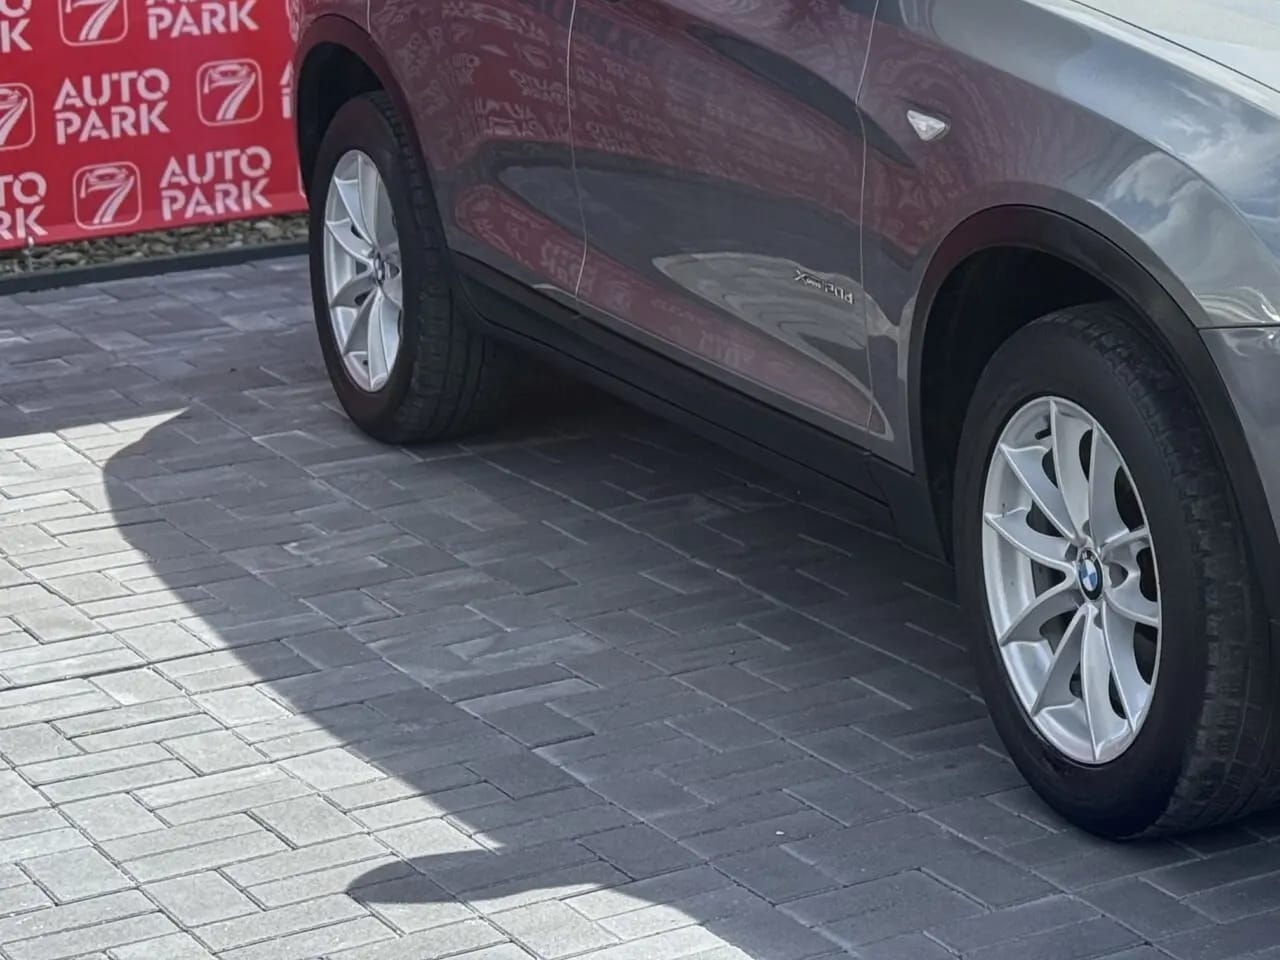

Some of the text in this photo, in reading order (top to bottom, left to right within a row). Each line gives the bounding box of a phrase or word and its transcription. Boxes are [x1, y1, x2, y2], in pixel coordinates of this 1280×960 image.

[148, 0, 258, 39] PARK
[54, 68, 169, 111] AUTO
[54, 100, 169, 144] PARK
[160, 146, 271, 188] AUTO
[160, 176, 272, 221] PARK
